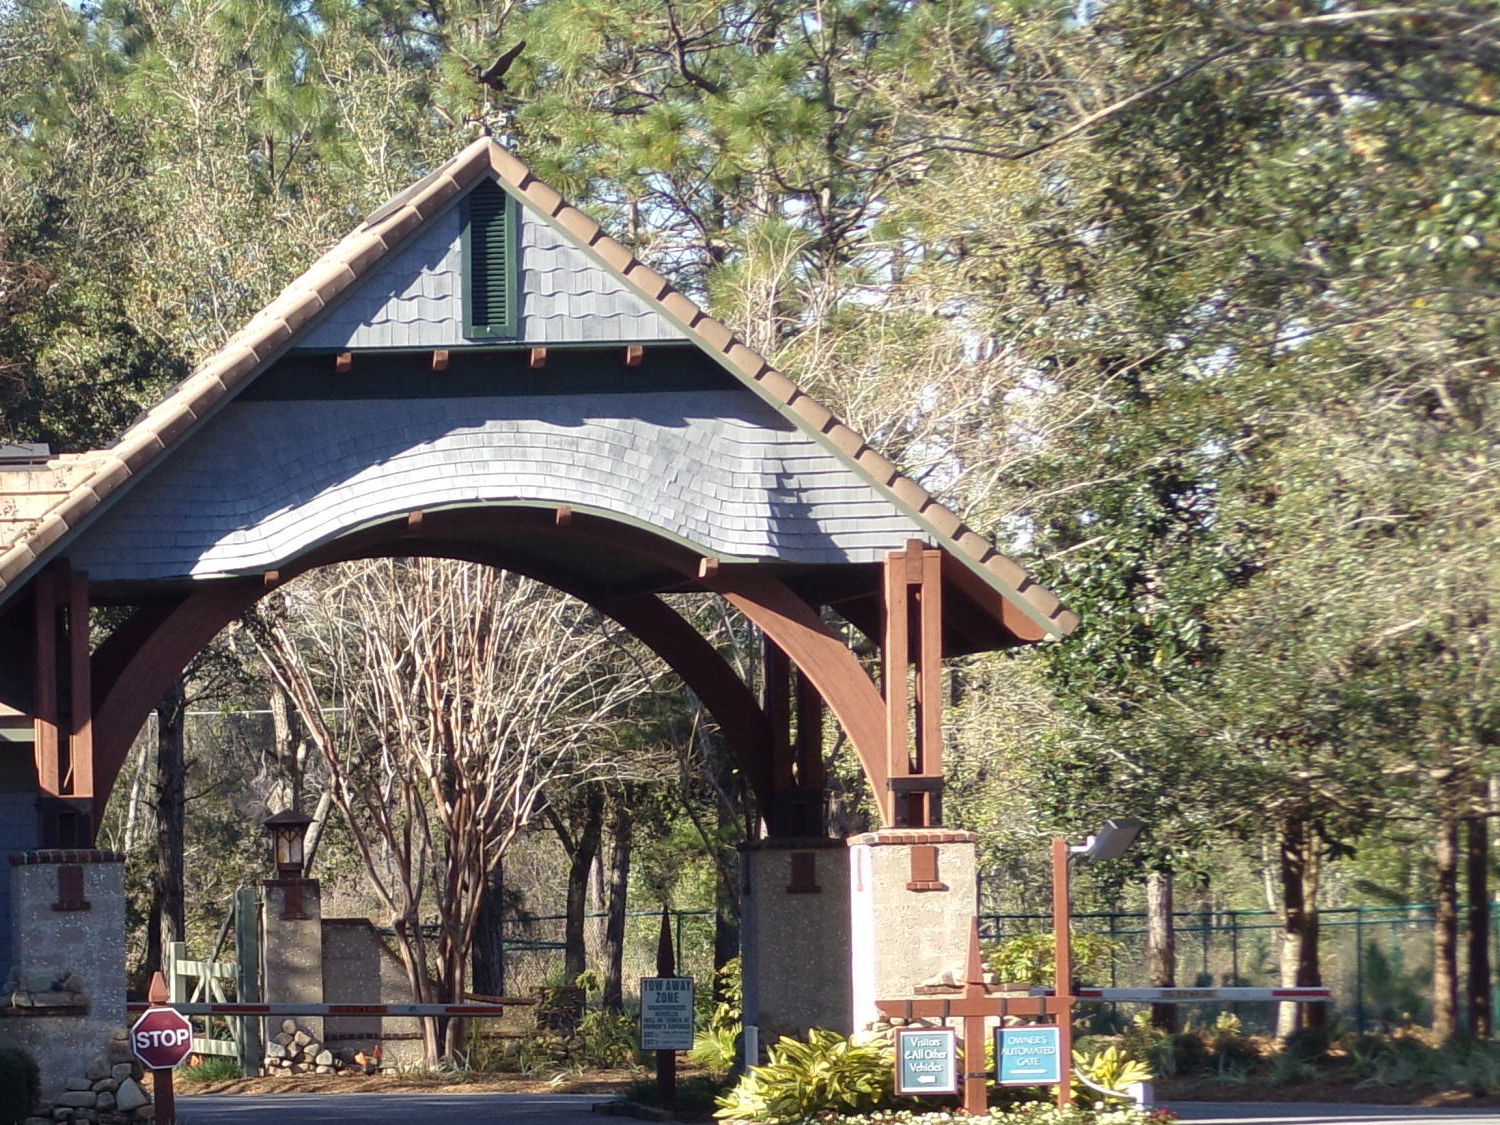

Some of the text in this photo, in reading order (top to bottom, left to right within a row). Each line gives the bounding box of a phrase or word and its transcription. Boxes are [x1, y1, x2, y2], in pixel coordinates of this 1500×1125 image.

[644, 980, 690, 991] TOW AWAY
[655, 992, 679, 1003] ZONE
[136, 1028, 189, 1049] STOP
[910, 1037, 942, 1047] Visitors
[925, 1049, 948, 1059] Other
[1001, 1046, 1056, 1056] AUTOMATED
[910, 1061, 943, 1072] Vehicles
[1017, 1057, 1041, 1066] GATE
